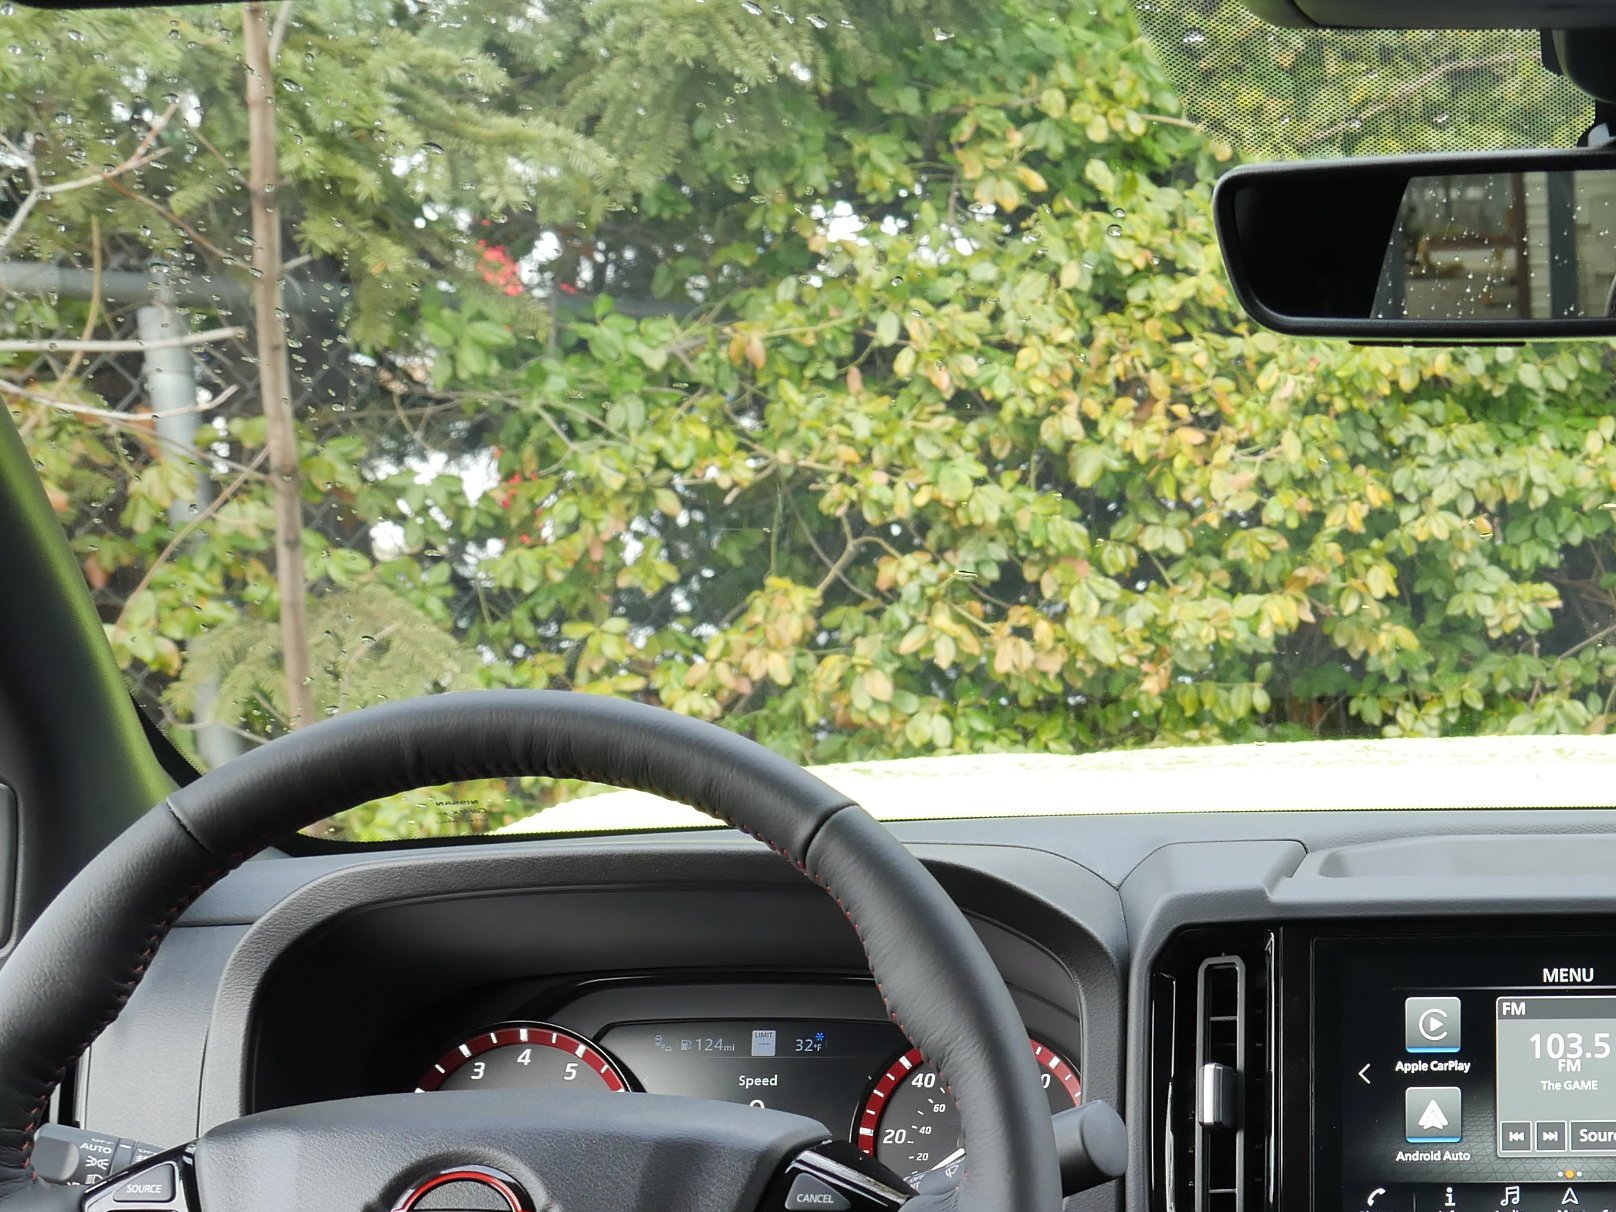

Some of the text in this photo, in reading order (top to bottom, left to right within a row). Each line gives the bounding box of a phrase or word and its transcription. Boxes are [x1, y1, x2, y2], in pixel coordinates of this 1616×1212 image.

[1542, 967, 1594, 983] MENU
[1502, 1003, 1526, 1015] FM
[1529, 1033, 1610, 1059] 103.5
[517, 1049, 532, 1065] 4
[471, 1062, 485, 1080] 3
[564, 1063, 579, 1081] 5
[1395, 1060, 1471, 1073] Apple CarPlay
[1558, 1059, 1581, 1072] FM
[739, 1074, 778, 1088] Speed
[912, 1073, 936, 1088] 40
[1541, 1080, 1598, 1090] The GAME
[933, 1104, 946, 1113] 60
[882, 1129, 906, 1144] 20
[919, 1126, 932, 1135] 40
[80, 1143, 112, 1154] AUTO
[916, 1152, 929, 1161] 20
[1396, 1150, 1471, 1161] Android Auto
[126, 1184, 162, 1193] SOURCE
[796, 1193, 834, 1203] CANCEL
